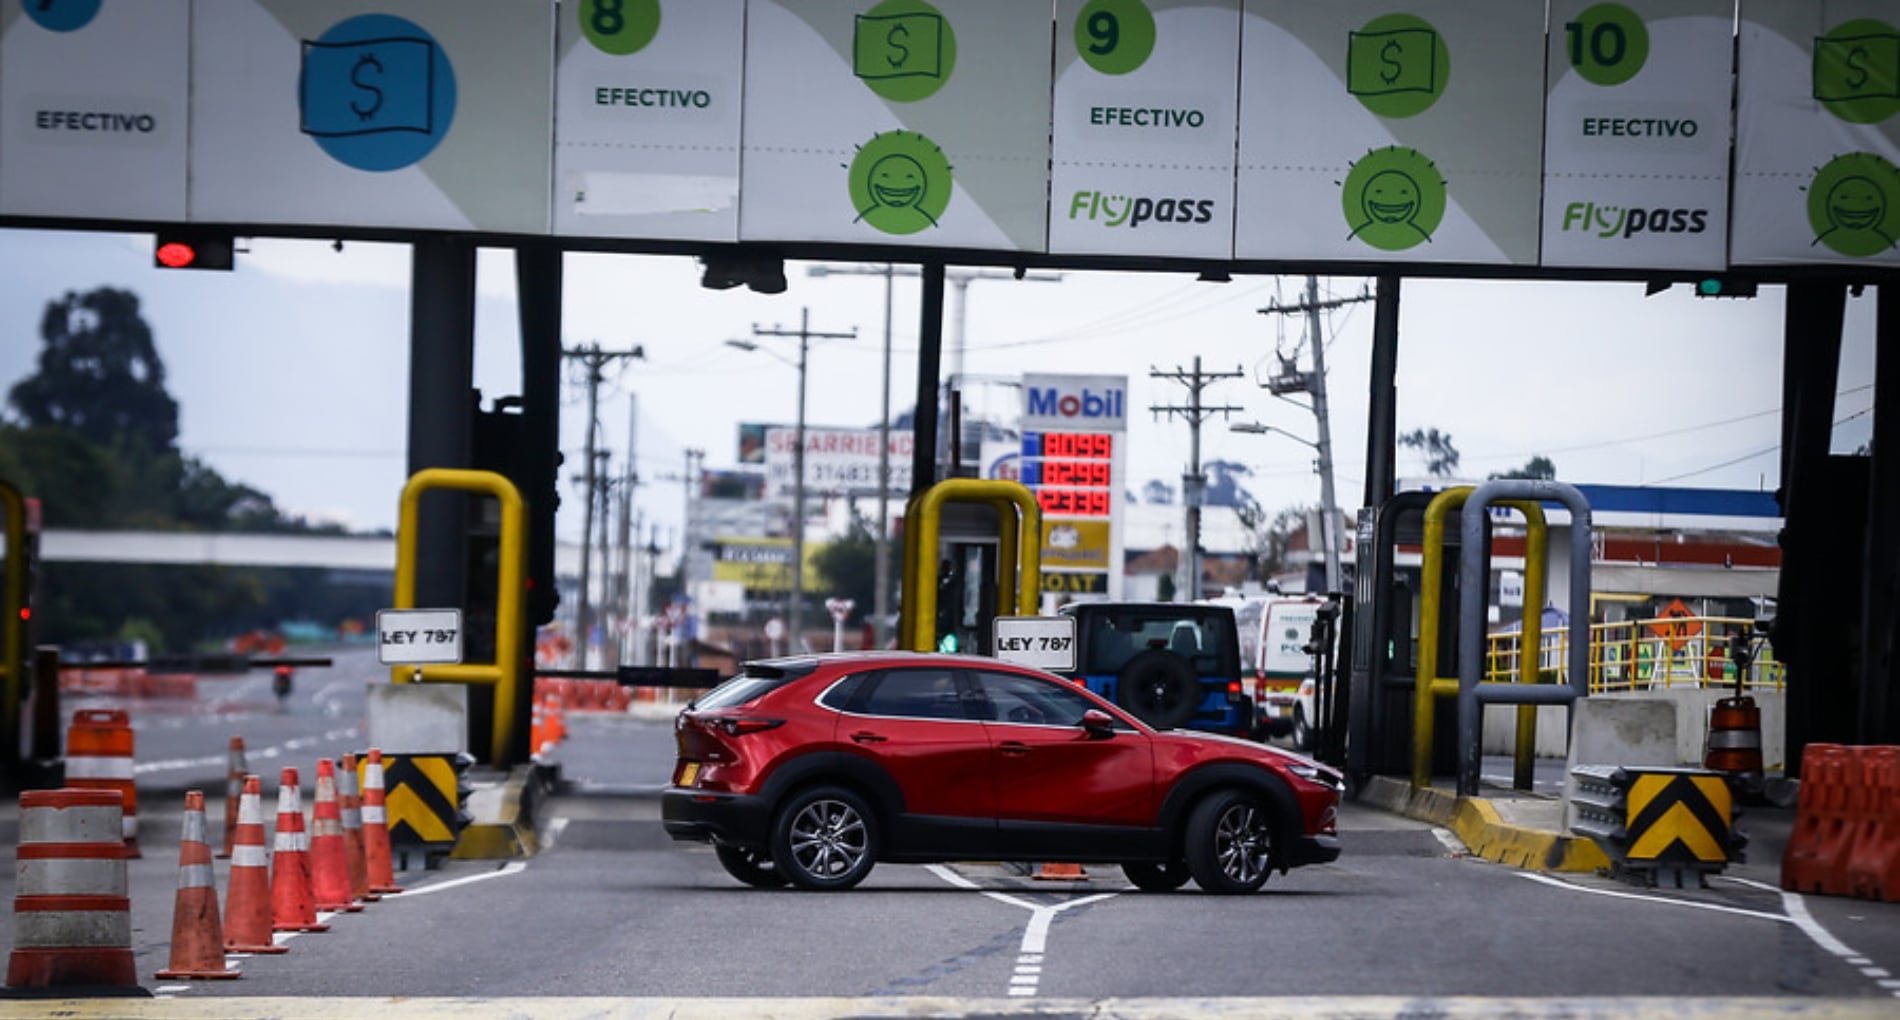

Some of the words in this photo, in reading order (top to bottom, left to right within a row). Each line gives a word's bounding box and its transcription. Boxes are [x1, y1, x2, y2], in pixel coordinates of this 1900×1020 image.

[591, 0, 625, 36] 8
[1087, 10, 1120, 56] 9
[1564, 21, 1627, 67] 10
[595, 87, 712, 109] EFECTIVO
[35, 110, 156, 132] EFECTIVO
[1090, 106, 1205, 128] EFECTIVO
[1582, 117, 1699, 138] EFECTIVO
[1028, 387, 1123, 418] Mobil
[1044, 431, 1112, 459] 8099
[381, 630, 417, 645] LEY
[423, 629, 457, 644] 787
[998, 637, 1033, 651] LEY
[1038, 637, 1072, 651] 787
